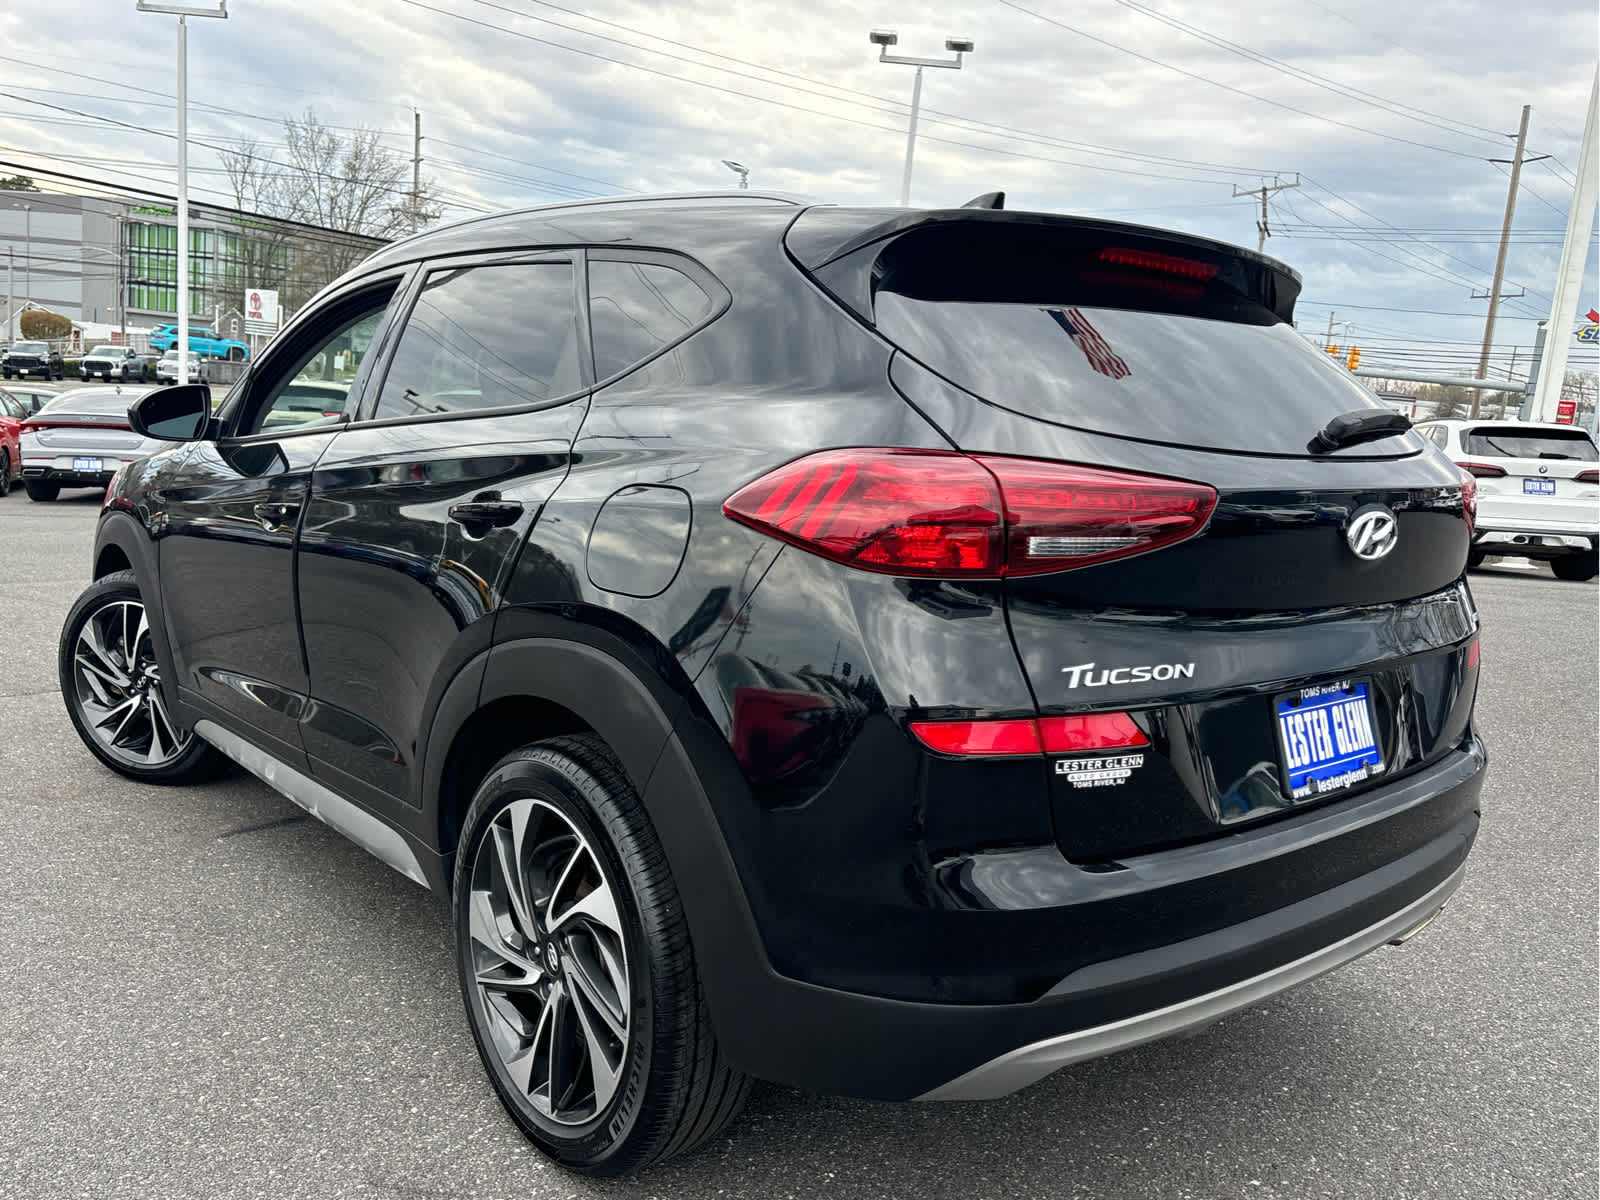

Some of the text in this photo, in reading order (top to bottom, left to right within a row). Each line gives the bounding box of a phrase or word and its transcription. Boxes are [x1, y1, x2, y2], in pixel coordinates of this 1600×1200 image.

[1300, 686, 1320, 699] TOMS
[1280, 699, 1375, 769] LESTER GLENN
[1055, 756, 1144, 772] LESTER GLENN
[1317, 769, 1367, 792] lesterglenn
[611, 1040, 647, 1135] MICHELIN
